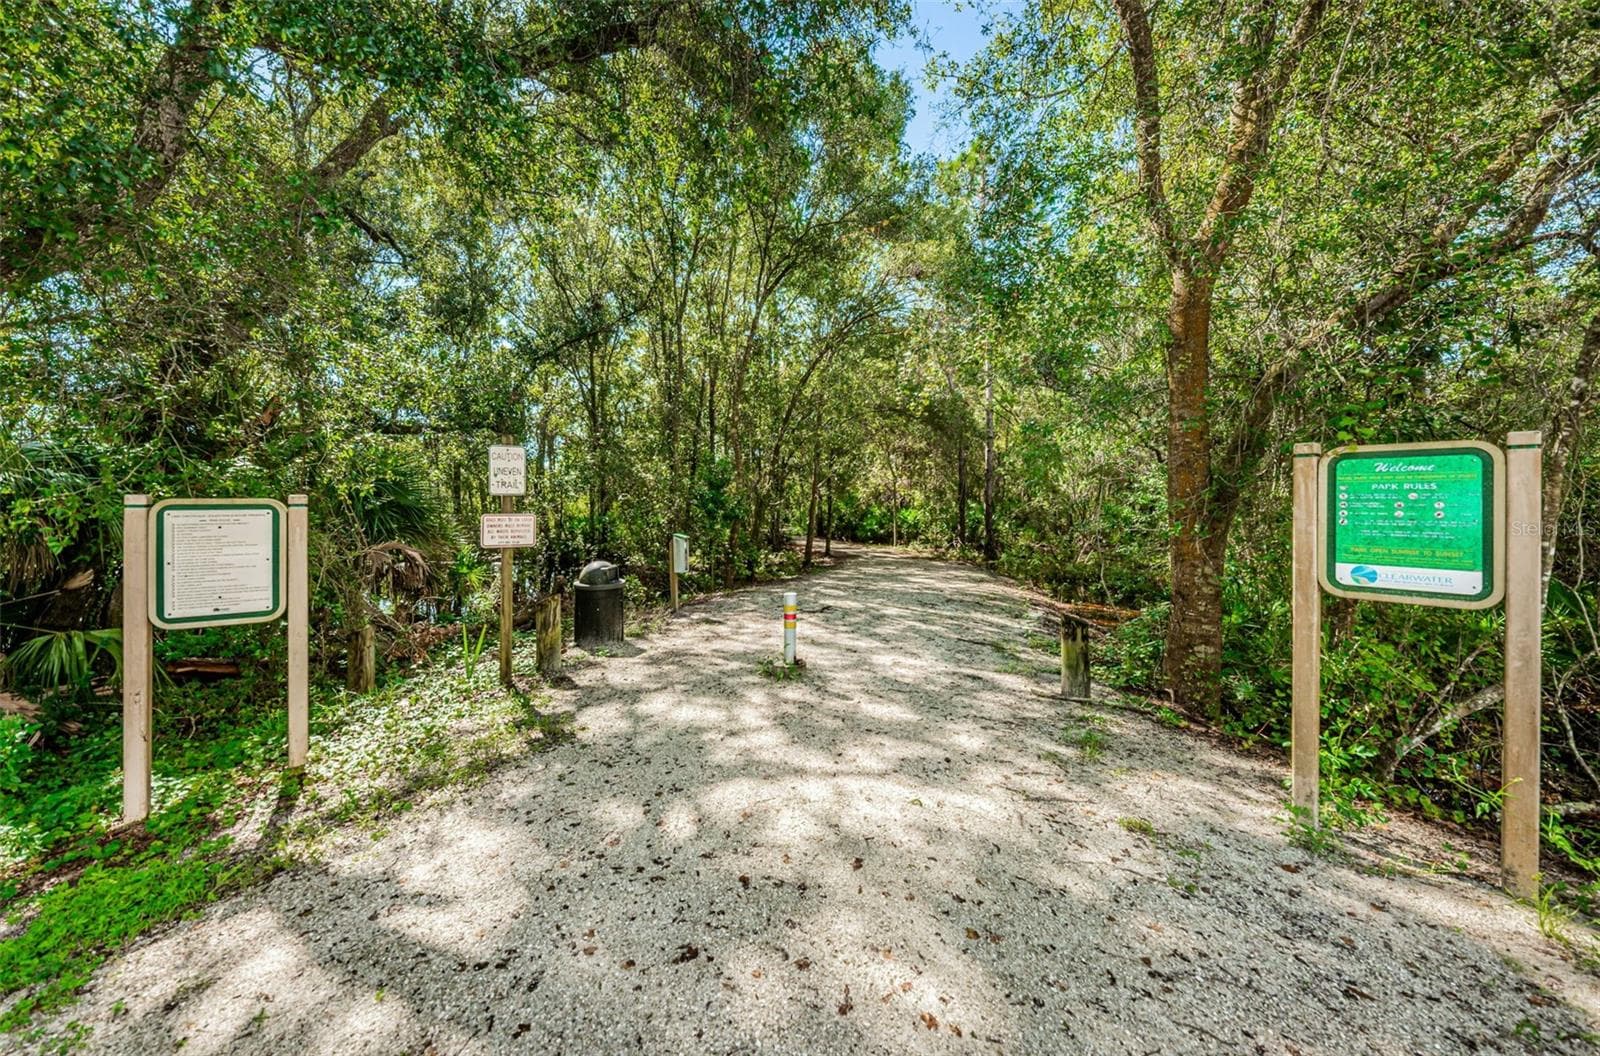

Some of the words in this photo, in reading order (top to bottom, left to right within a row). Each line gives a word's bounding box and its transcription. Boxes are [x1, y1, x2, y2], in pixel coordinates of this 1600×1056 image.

[492, 452, 523, 461] CAUTION
[493, 467, 522, 476] UNEVEN
[1373, 462, 1436, 473] Welcome
[495, 480, 520, 489] TRAIL
[1403, 482, 1438, 490] RULES
[1379, 573, 1453, 584] CLEARWATER
